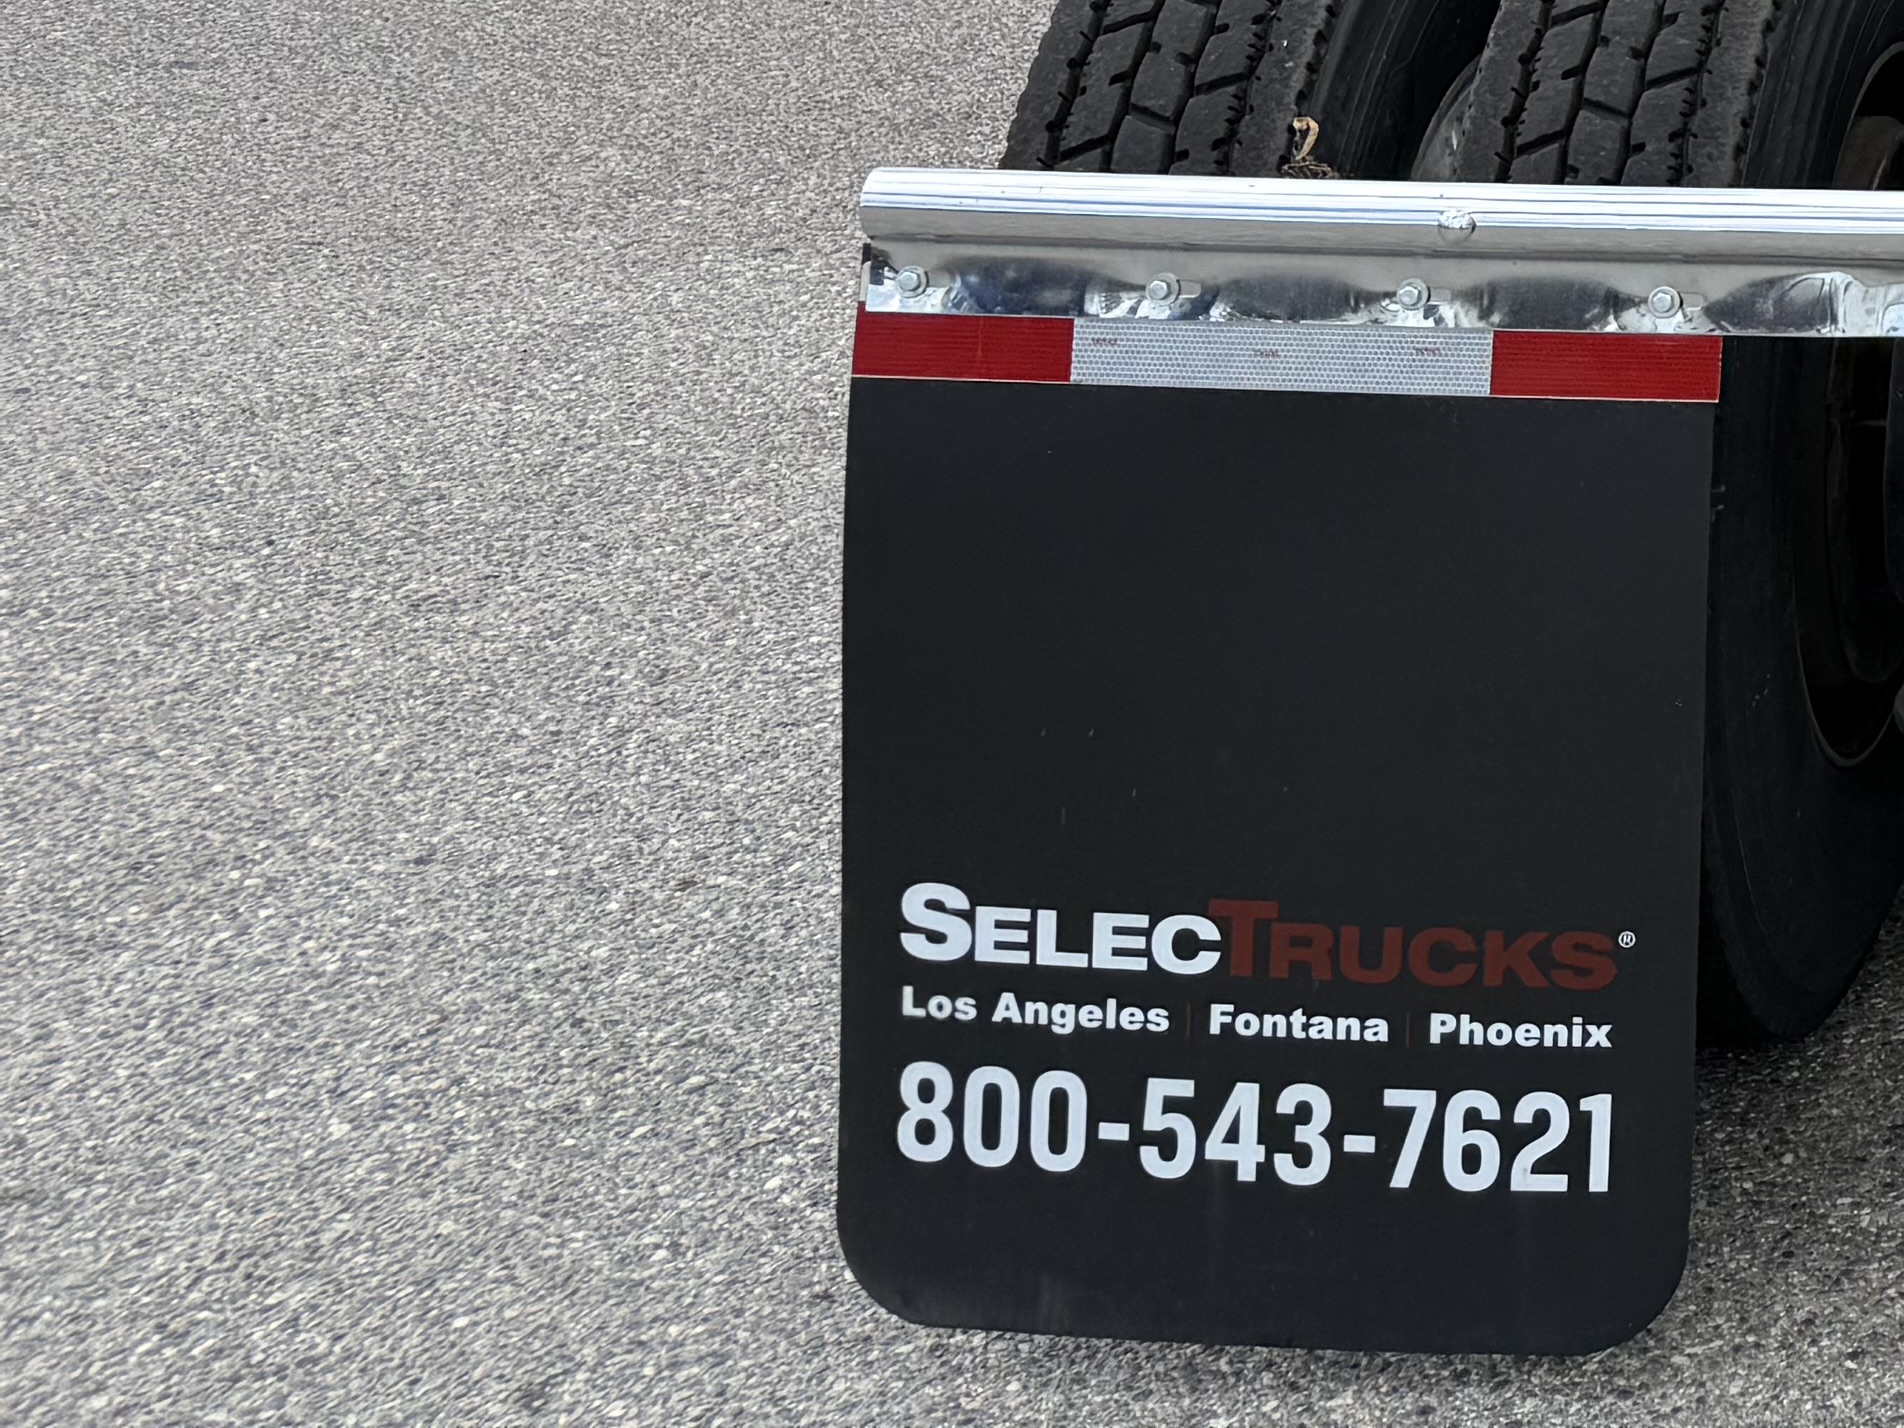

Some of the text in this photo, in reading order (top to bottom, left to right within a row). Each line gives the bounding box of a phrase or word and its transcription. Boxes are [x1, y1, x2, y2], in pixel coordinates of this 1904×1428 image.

[903, 985, 1613, 1048] Los Angeles Fontana Phoenix
[897, 1061, 1613, 1193] 800-543-7621
